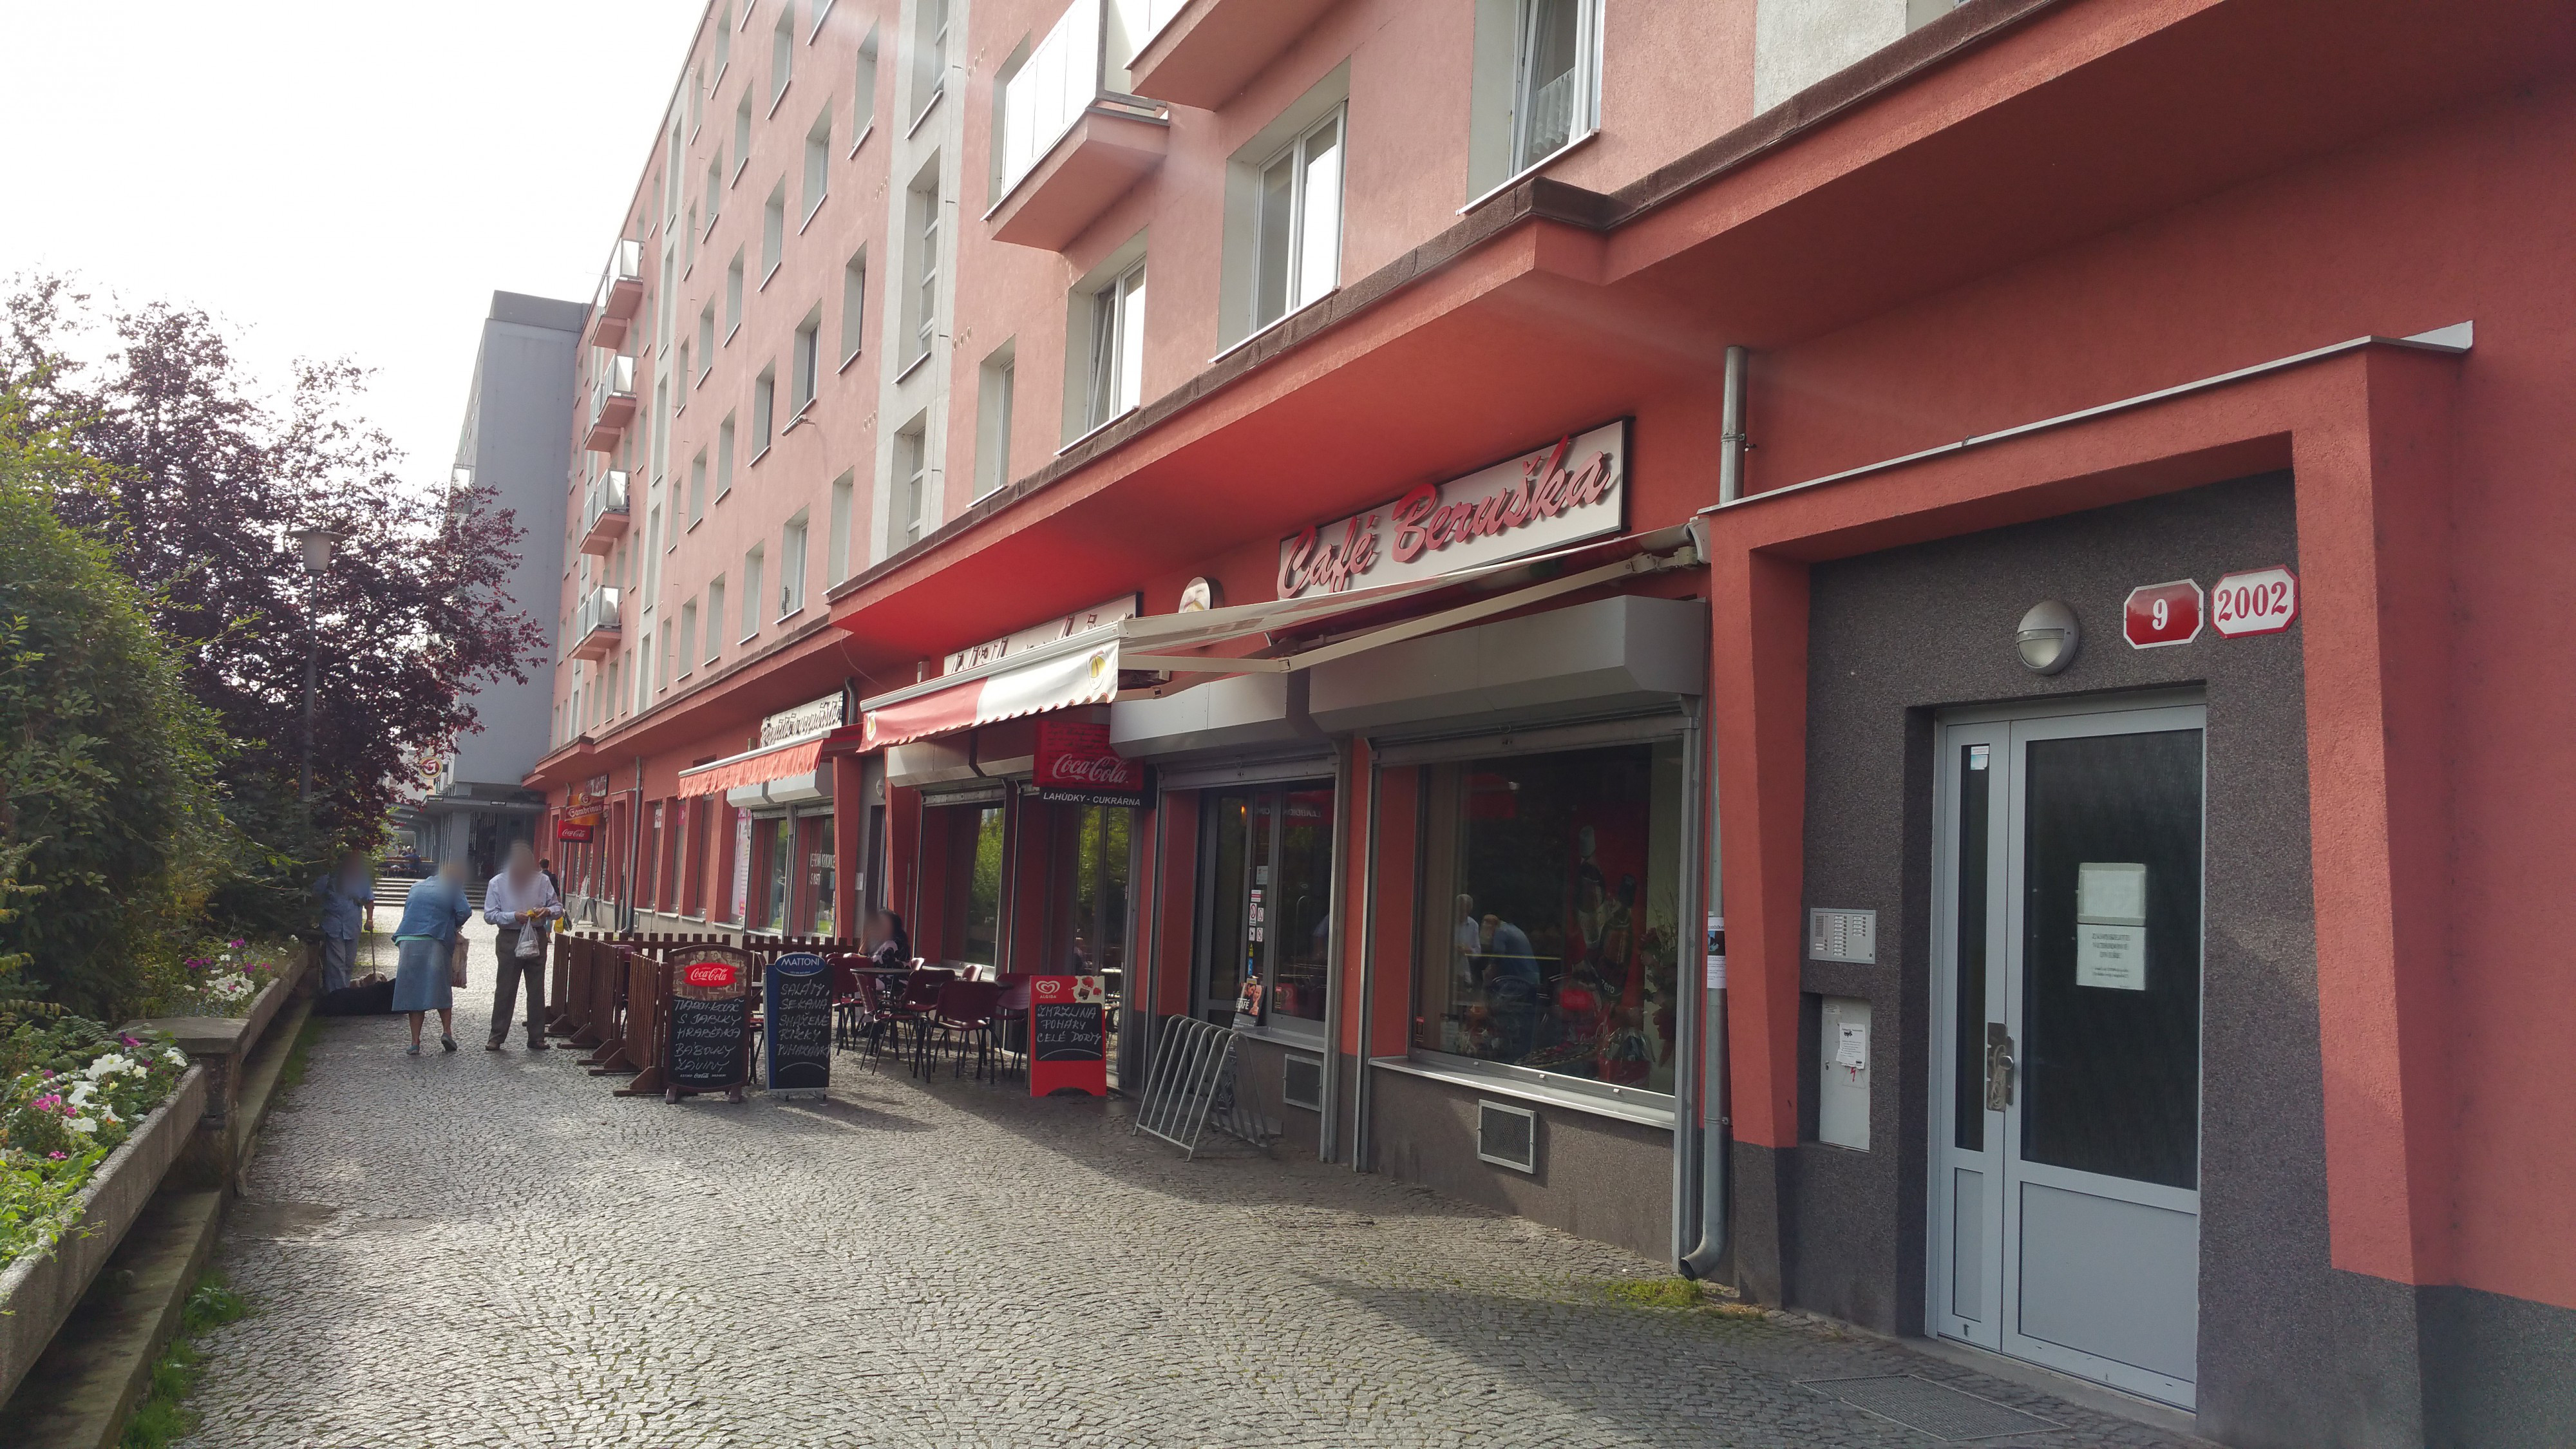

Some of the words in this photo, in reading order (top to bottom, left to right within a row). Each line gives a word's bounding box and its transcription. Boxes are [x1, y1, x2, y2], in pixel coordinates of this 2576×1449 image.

[1277, 515, 1375, 598] Café
[1392, 434, 1611, 562] Beruška
[2218, 581, 2288, 622] 2002
[2152, 598, 2168, 630] 9
[1052, 753, 1129, 784] Coca-Cola
[1093, 795, 1141, 806] CUKRÁRNA
[569, 805, 602, 817] Gambrinus
[562, 829, 586, 837] Coca-Cola
[781, 958, 820, 966] MATTONI
[690, 967, 729, 981] Coca-Cola
[1037, 1005, 1096, 1019] ZMRZLINA
[677, 1014, 688, 1024] S
[690, 1013, 741, 1027] JABLKY
[1041, 1018, 1086, 1030] POHÁRY
[1037, 1030, 1066, 1042] CELÉ
[1071, 1032, 1102, 1045] DORTY
[674, 1041, 736, 1058] BÁBOVKY
